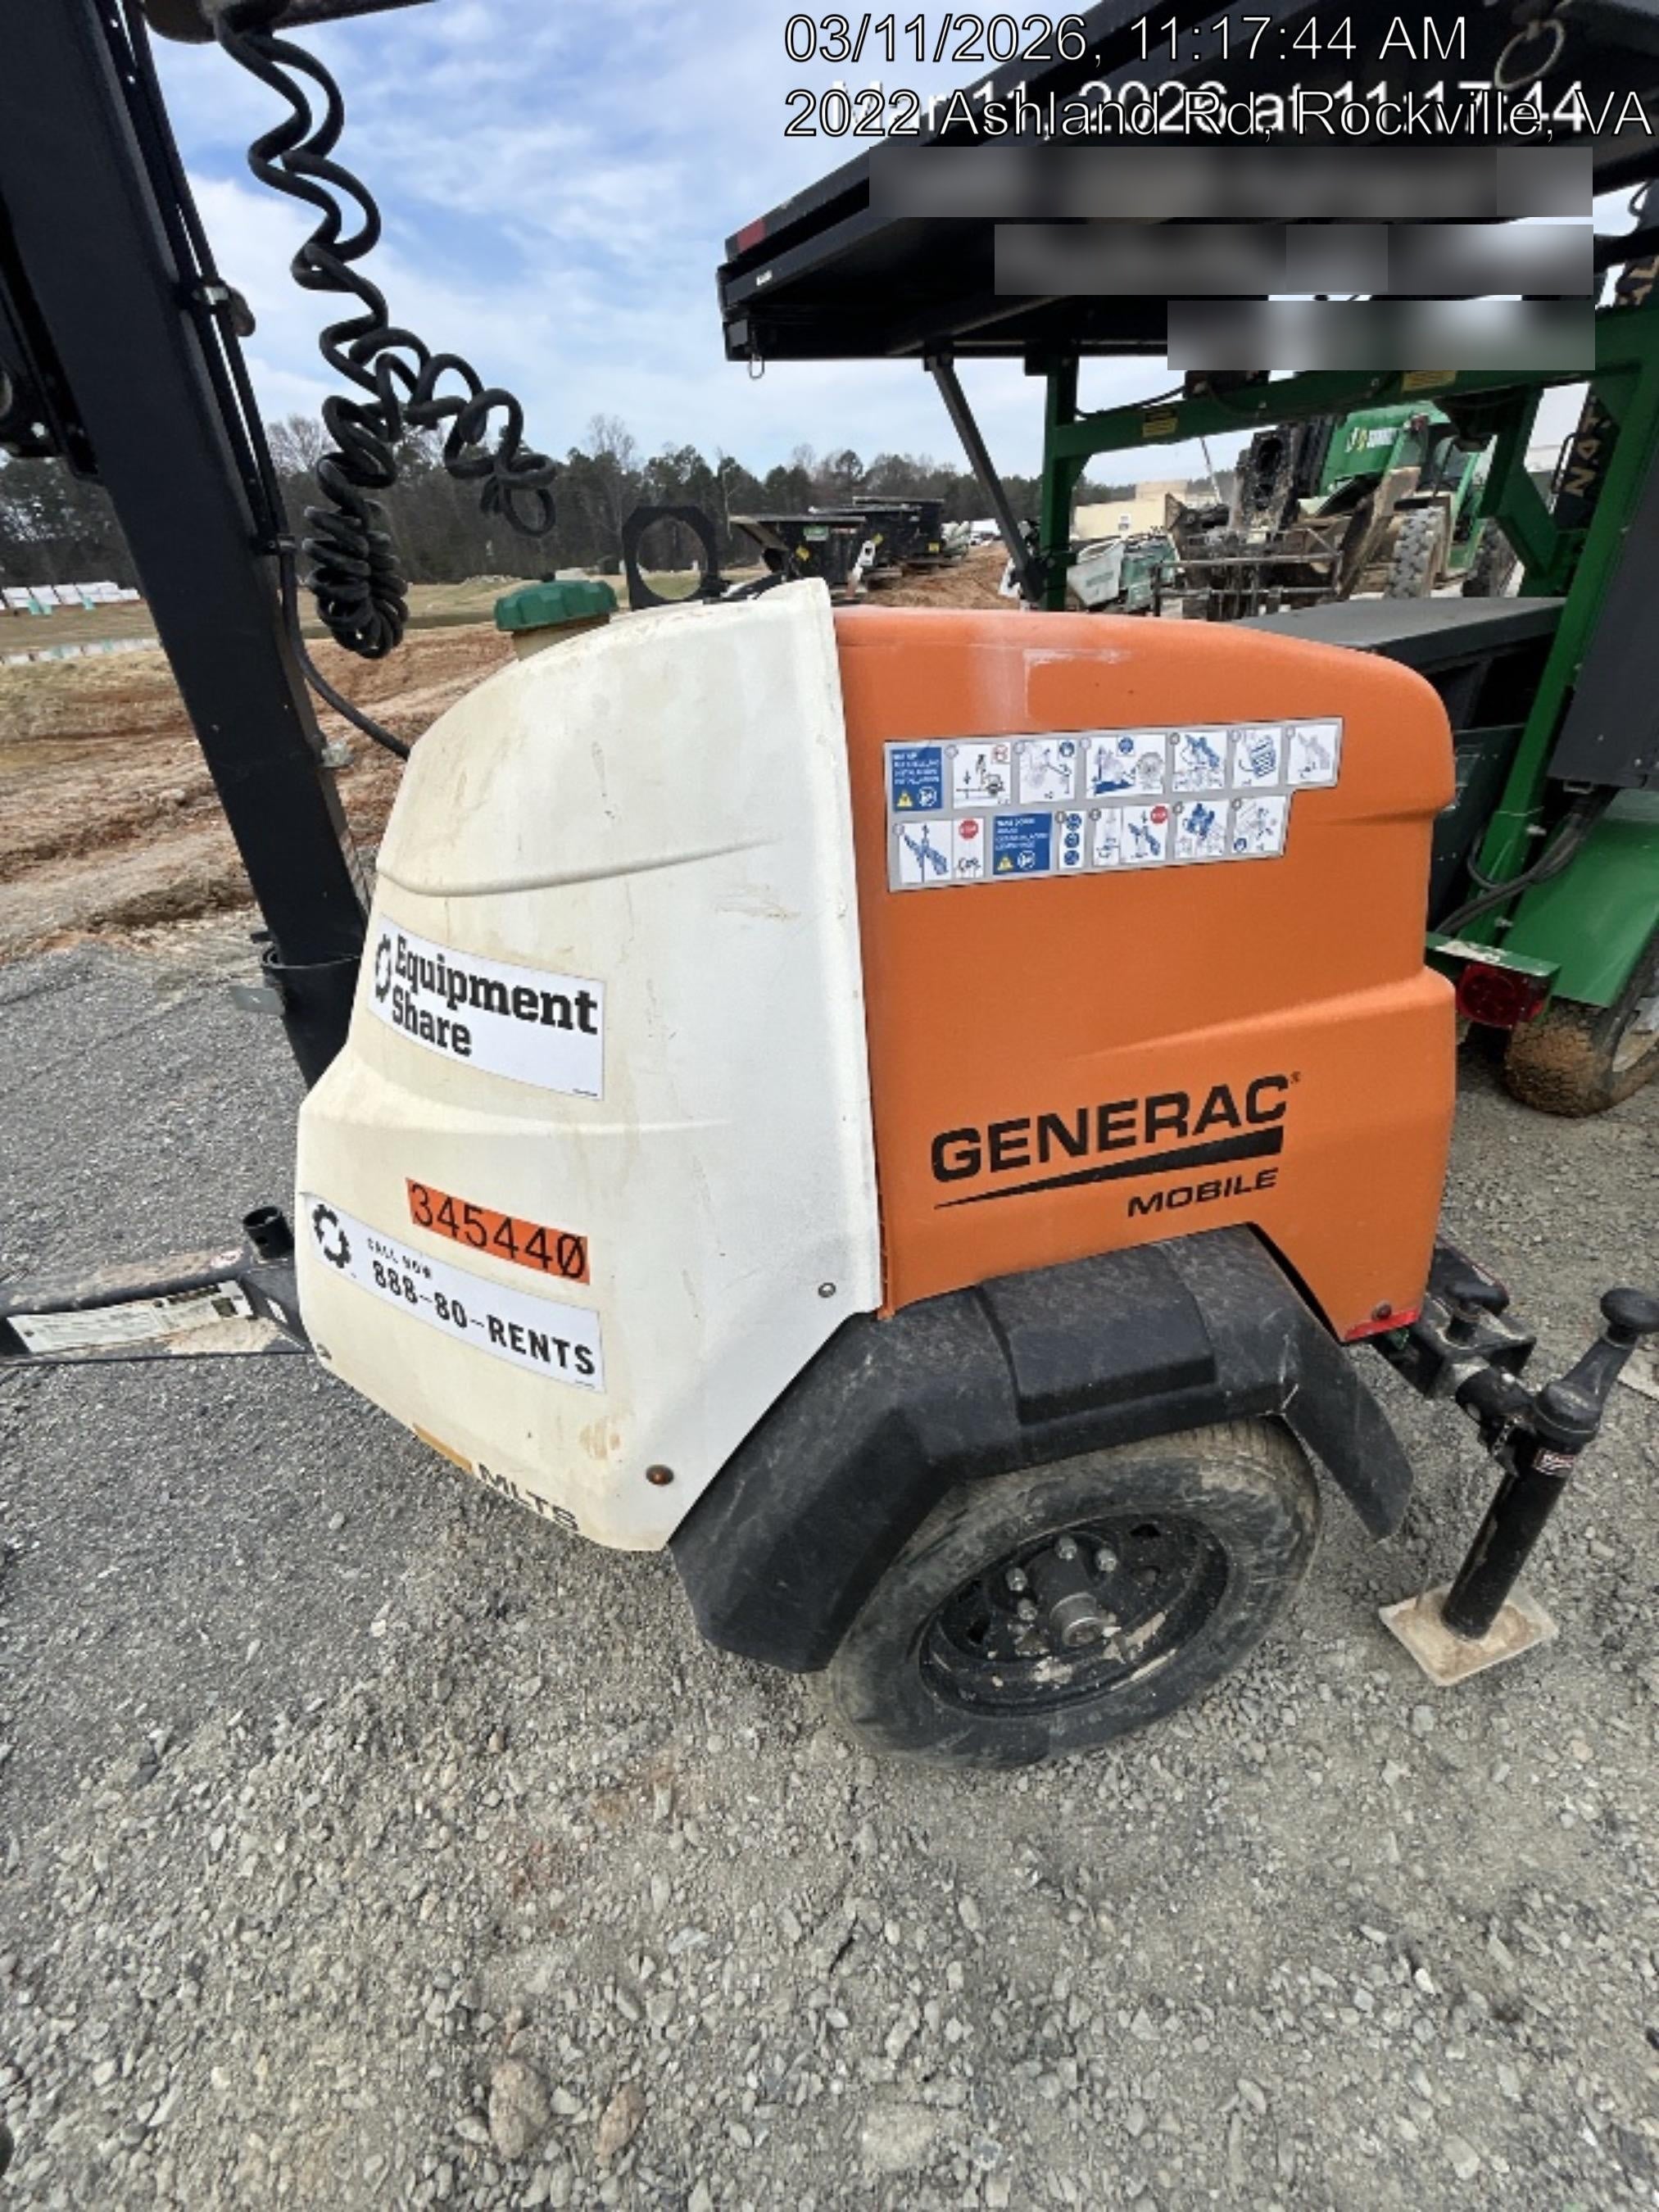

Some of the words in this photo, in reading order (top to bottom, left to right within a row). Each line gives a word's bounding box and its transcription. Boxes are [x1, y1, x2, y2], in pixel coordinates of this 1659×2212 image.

[392, 984, 473, 1057] Share
[395, 934, 598, 1035] Equipment
[931, 1074, 1288, 1182] GENERAC
[411, 1183, 587, 1280] 345440
[1127, 1167, 1279, 1217] MOBILE
[371, 1260, 596, 1376] 888-80-RENTS
